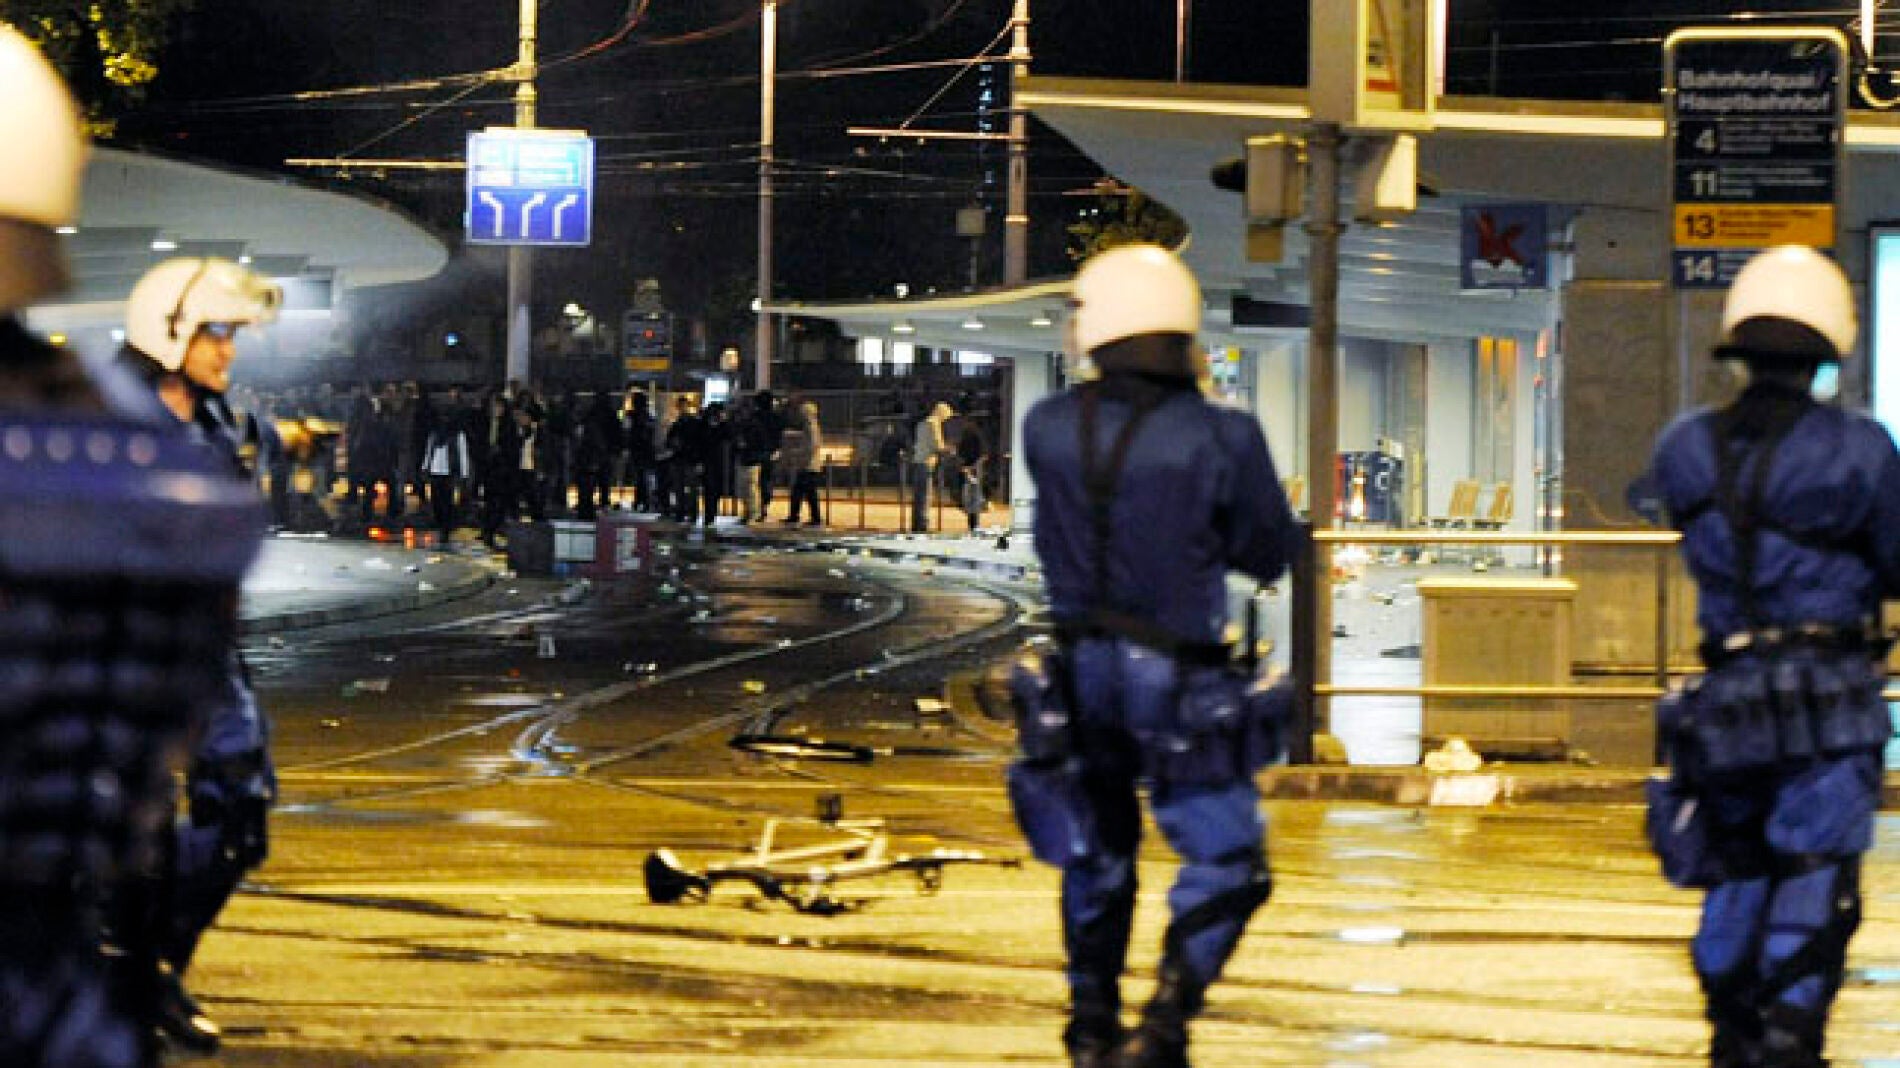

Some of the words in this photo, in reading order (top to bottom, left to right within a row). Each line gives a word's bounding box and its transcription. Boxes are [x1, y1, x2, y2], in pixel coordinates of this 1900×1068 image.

[1679, 92, 1830, 112] Hauptbahnhof
[1695, 129, 1716, 154] 4
[1690, 170, 1716, 196] 11
[1684, 214, 1715, 239] 13
[1681, 256, 1715, 281] 14
